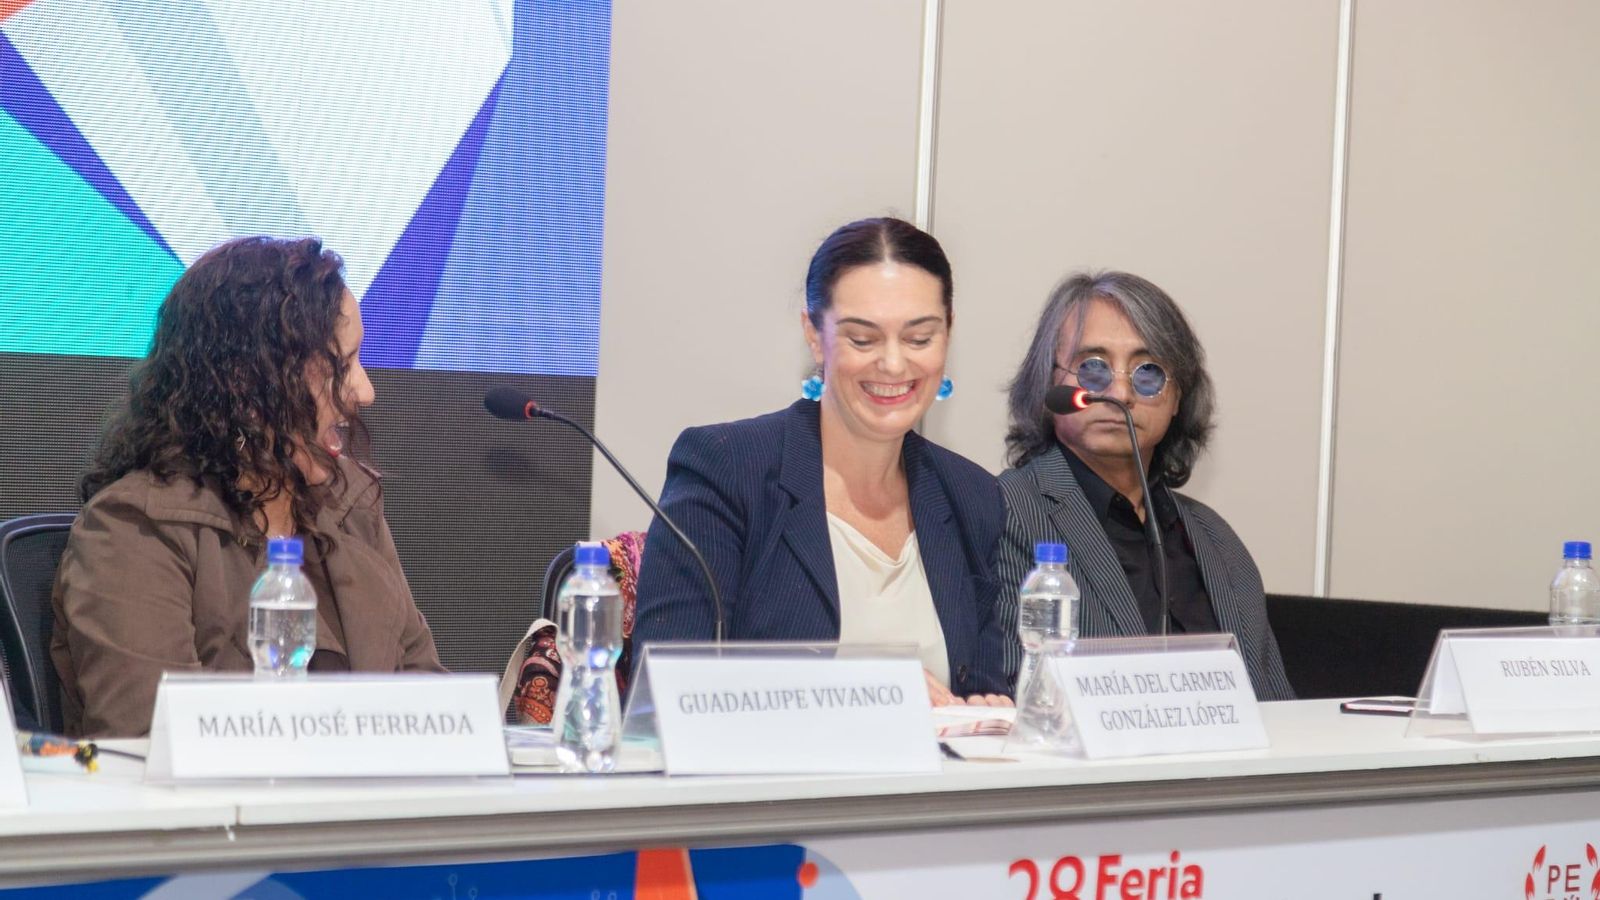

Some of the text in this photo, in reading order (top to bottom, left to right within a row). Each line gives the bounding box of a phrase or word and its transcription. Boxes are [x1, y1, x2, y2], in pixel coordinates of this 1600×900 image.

[1500, 656, 1591, 677] RUBÉN SILVA
[1076, 670, 1238, 697] MARÍA DEL CARMEN
[679, 685, 904, 714] GUADALUPE VIVANCO
[199, 709, 474, 741] MARÍA JOSÉ FERRADA
[1100, 700, 1239, 731] GONZÁLEZ LÓPEZ
[1095, 850, 1204, 900] Feria
[1547, 864, 1582, 893] PE
